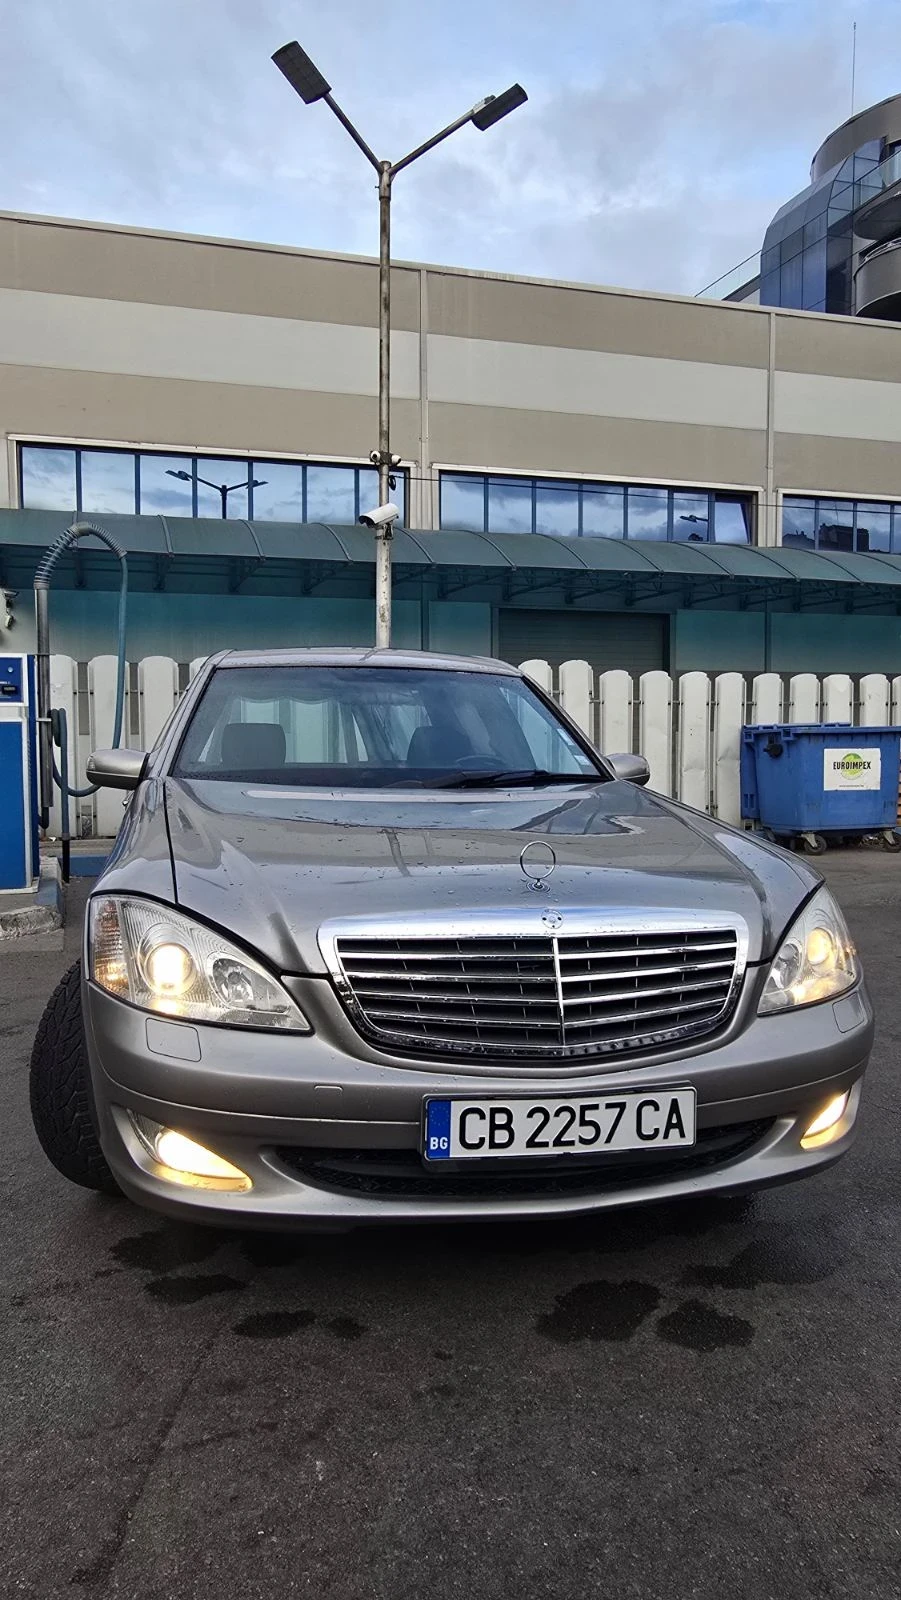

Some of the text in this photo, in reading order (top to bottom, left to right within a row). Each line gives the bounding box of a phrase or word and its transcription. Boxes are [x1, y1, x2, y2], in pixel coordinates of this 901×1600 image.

[833, 761, 871, 770] EUROIMPEX
[459, 1098, 686, 1150] CB 2257 CA
[429, 1137, 448, 1150] BG
